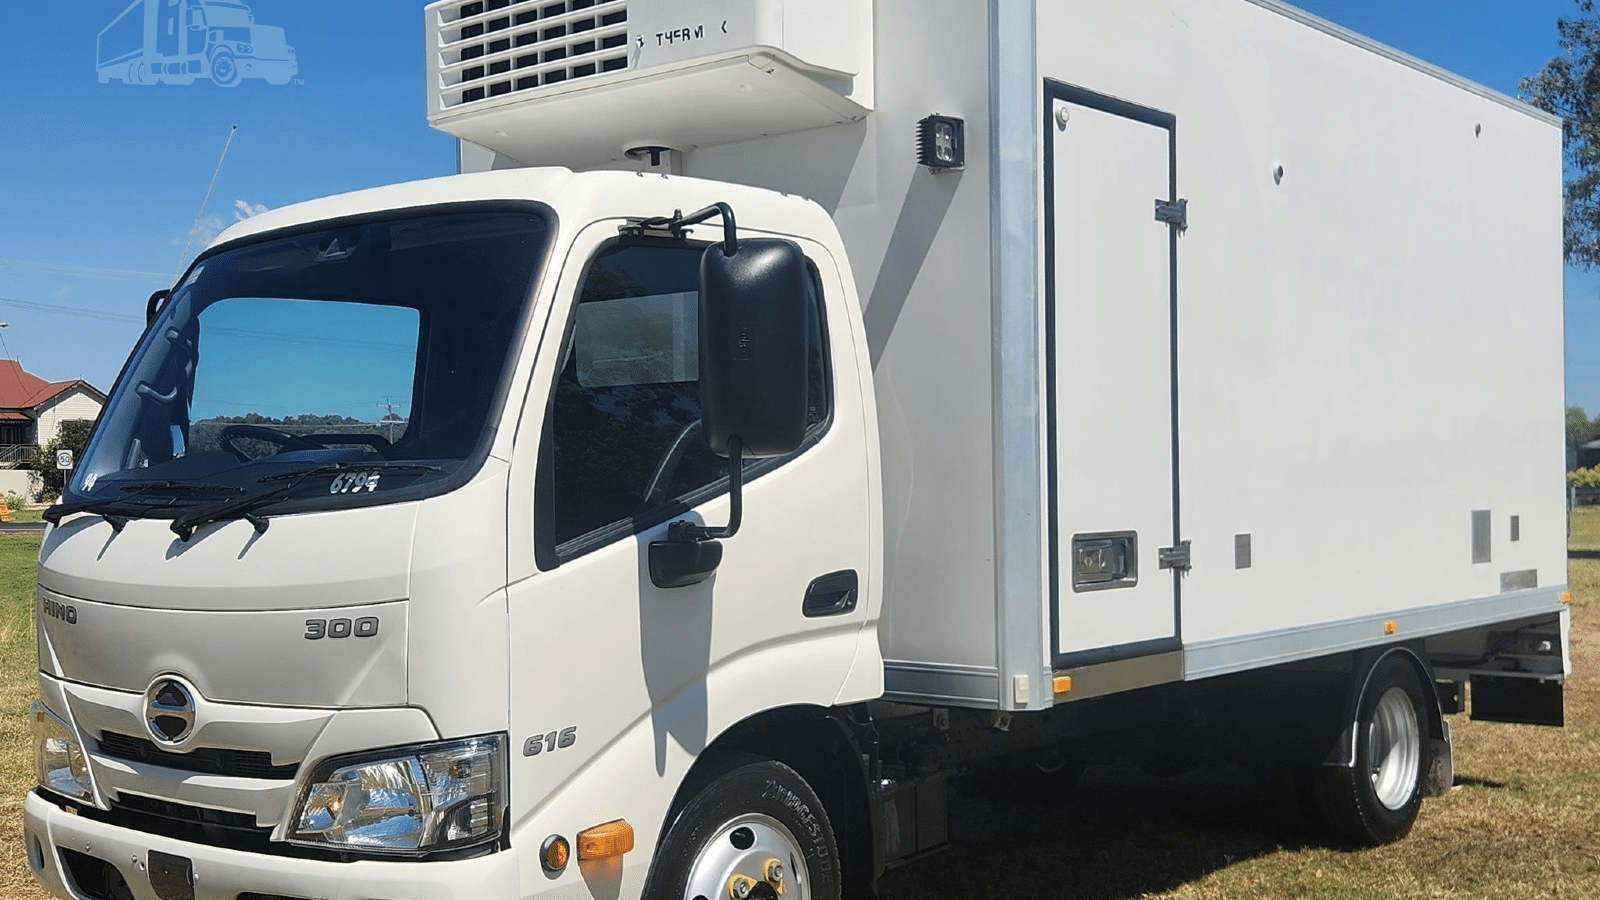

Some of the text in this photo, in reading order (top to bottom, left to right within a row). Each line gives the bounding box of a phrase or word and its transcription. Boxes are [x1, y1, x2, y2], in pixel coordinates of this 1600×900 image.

[329, 471, 381, 494] 6794
[42, 595, 78, 625] HINO
[304, 616, 380, 641] 300
[522, 725, 577, 757] 616
